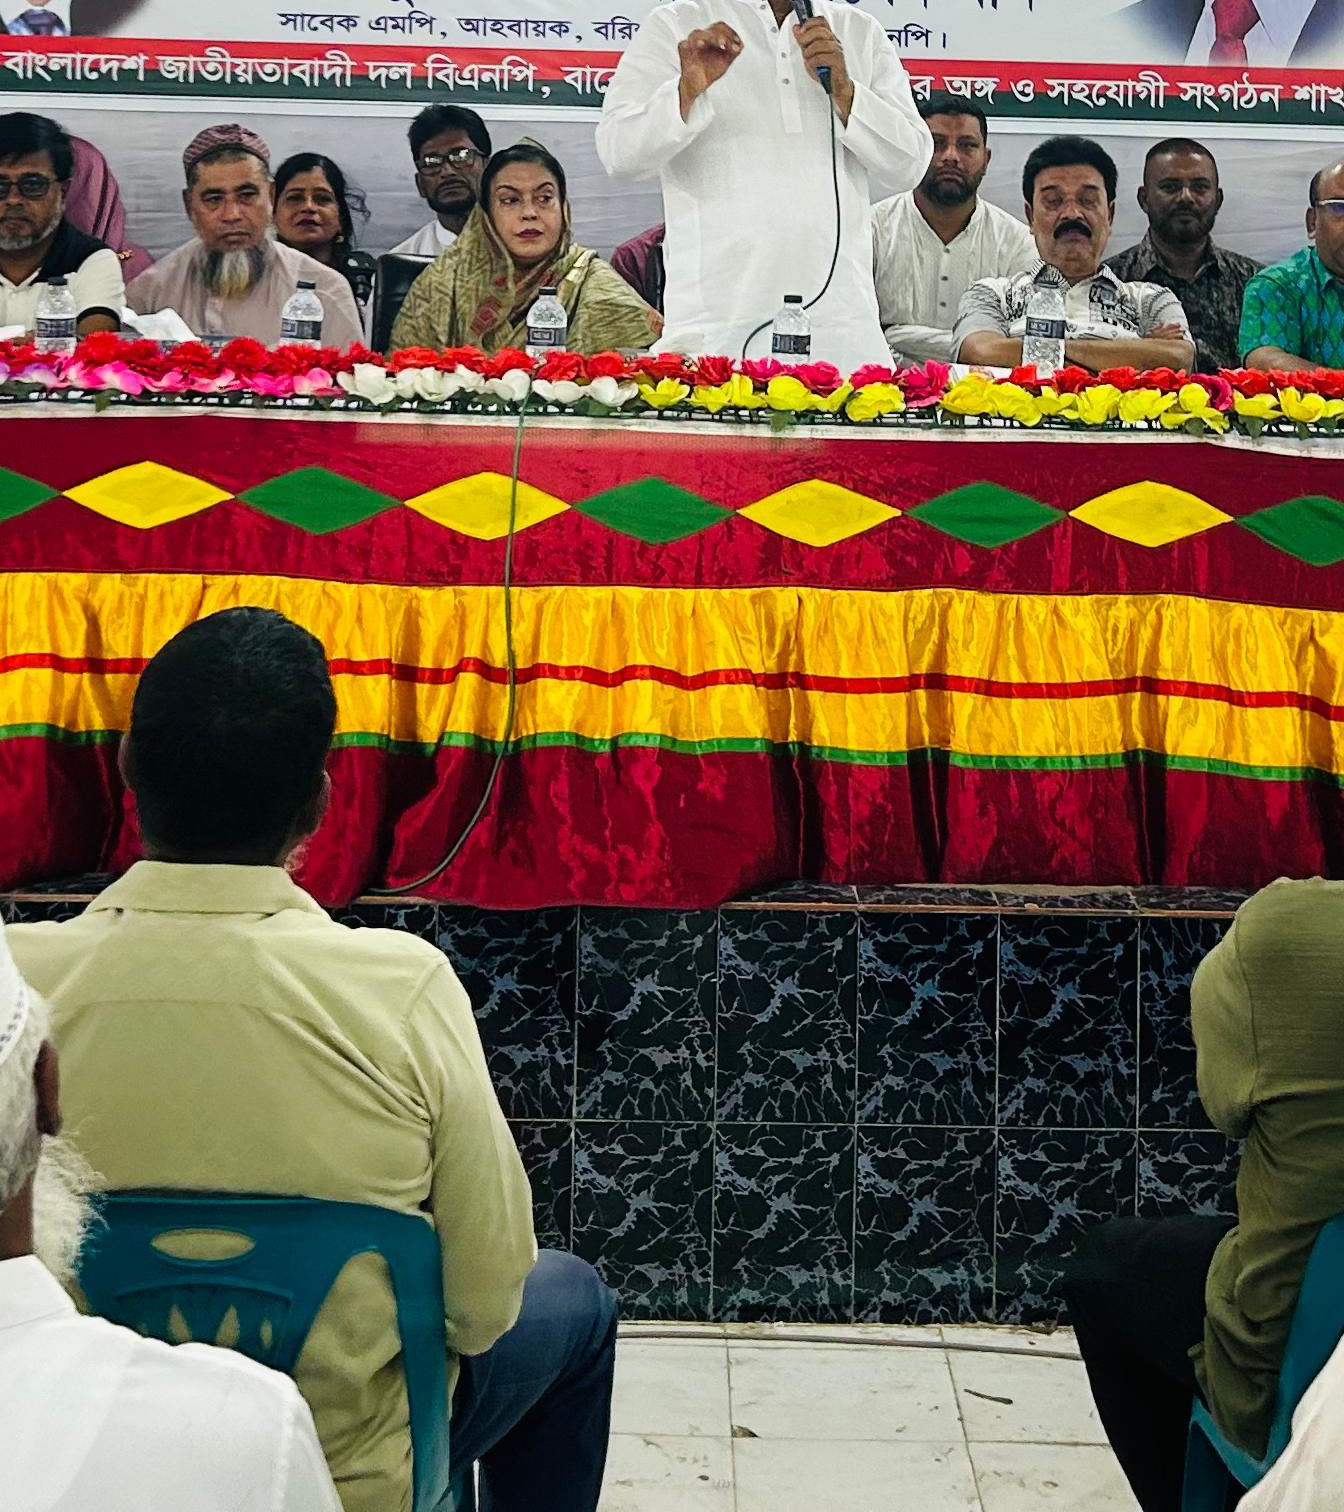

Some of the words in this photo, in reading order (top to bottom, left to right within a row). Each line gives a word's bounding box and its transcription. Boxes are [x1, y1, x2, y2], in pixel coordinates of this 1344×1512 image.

[278, 12, 360, 33] সাবেক
[592, 16, 640, 41] বরি
[0, 49, 149, 82] বাংলাদেশ
[156, 46, 357, 87] জাতীয়তাবাদী
[364, 59, 416, 90] দল
[943, 76, 1000, 105] অঙ্গ
[1010, 81, 1035, 102] ও
[1046, 71, 1170, 108] সহযোগী
[1179, 78, 1283, 113] সংগঠন
